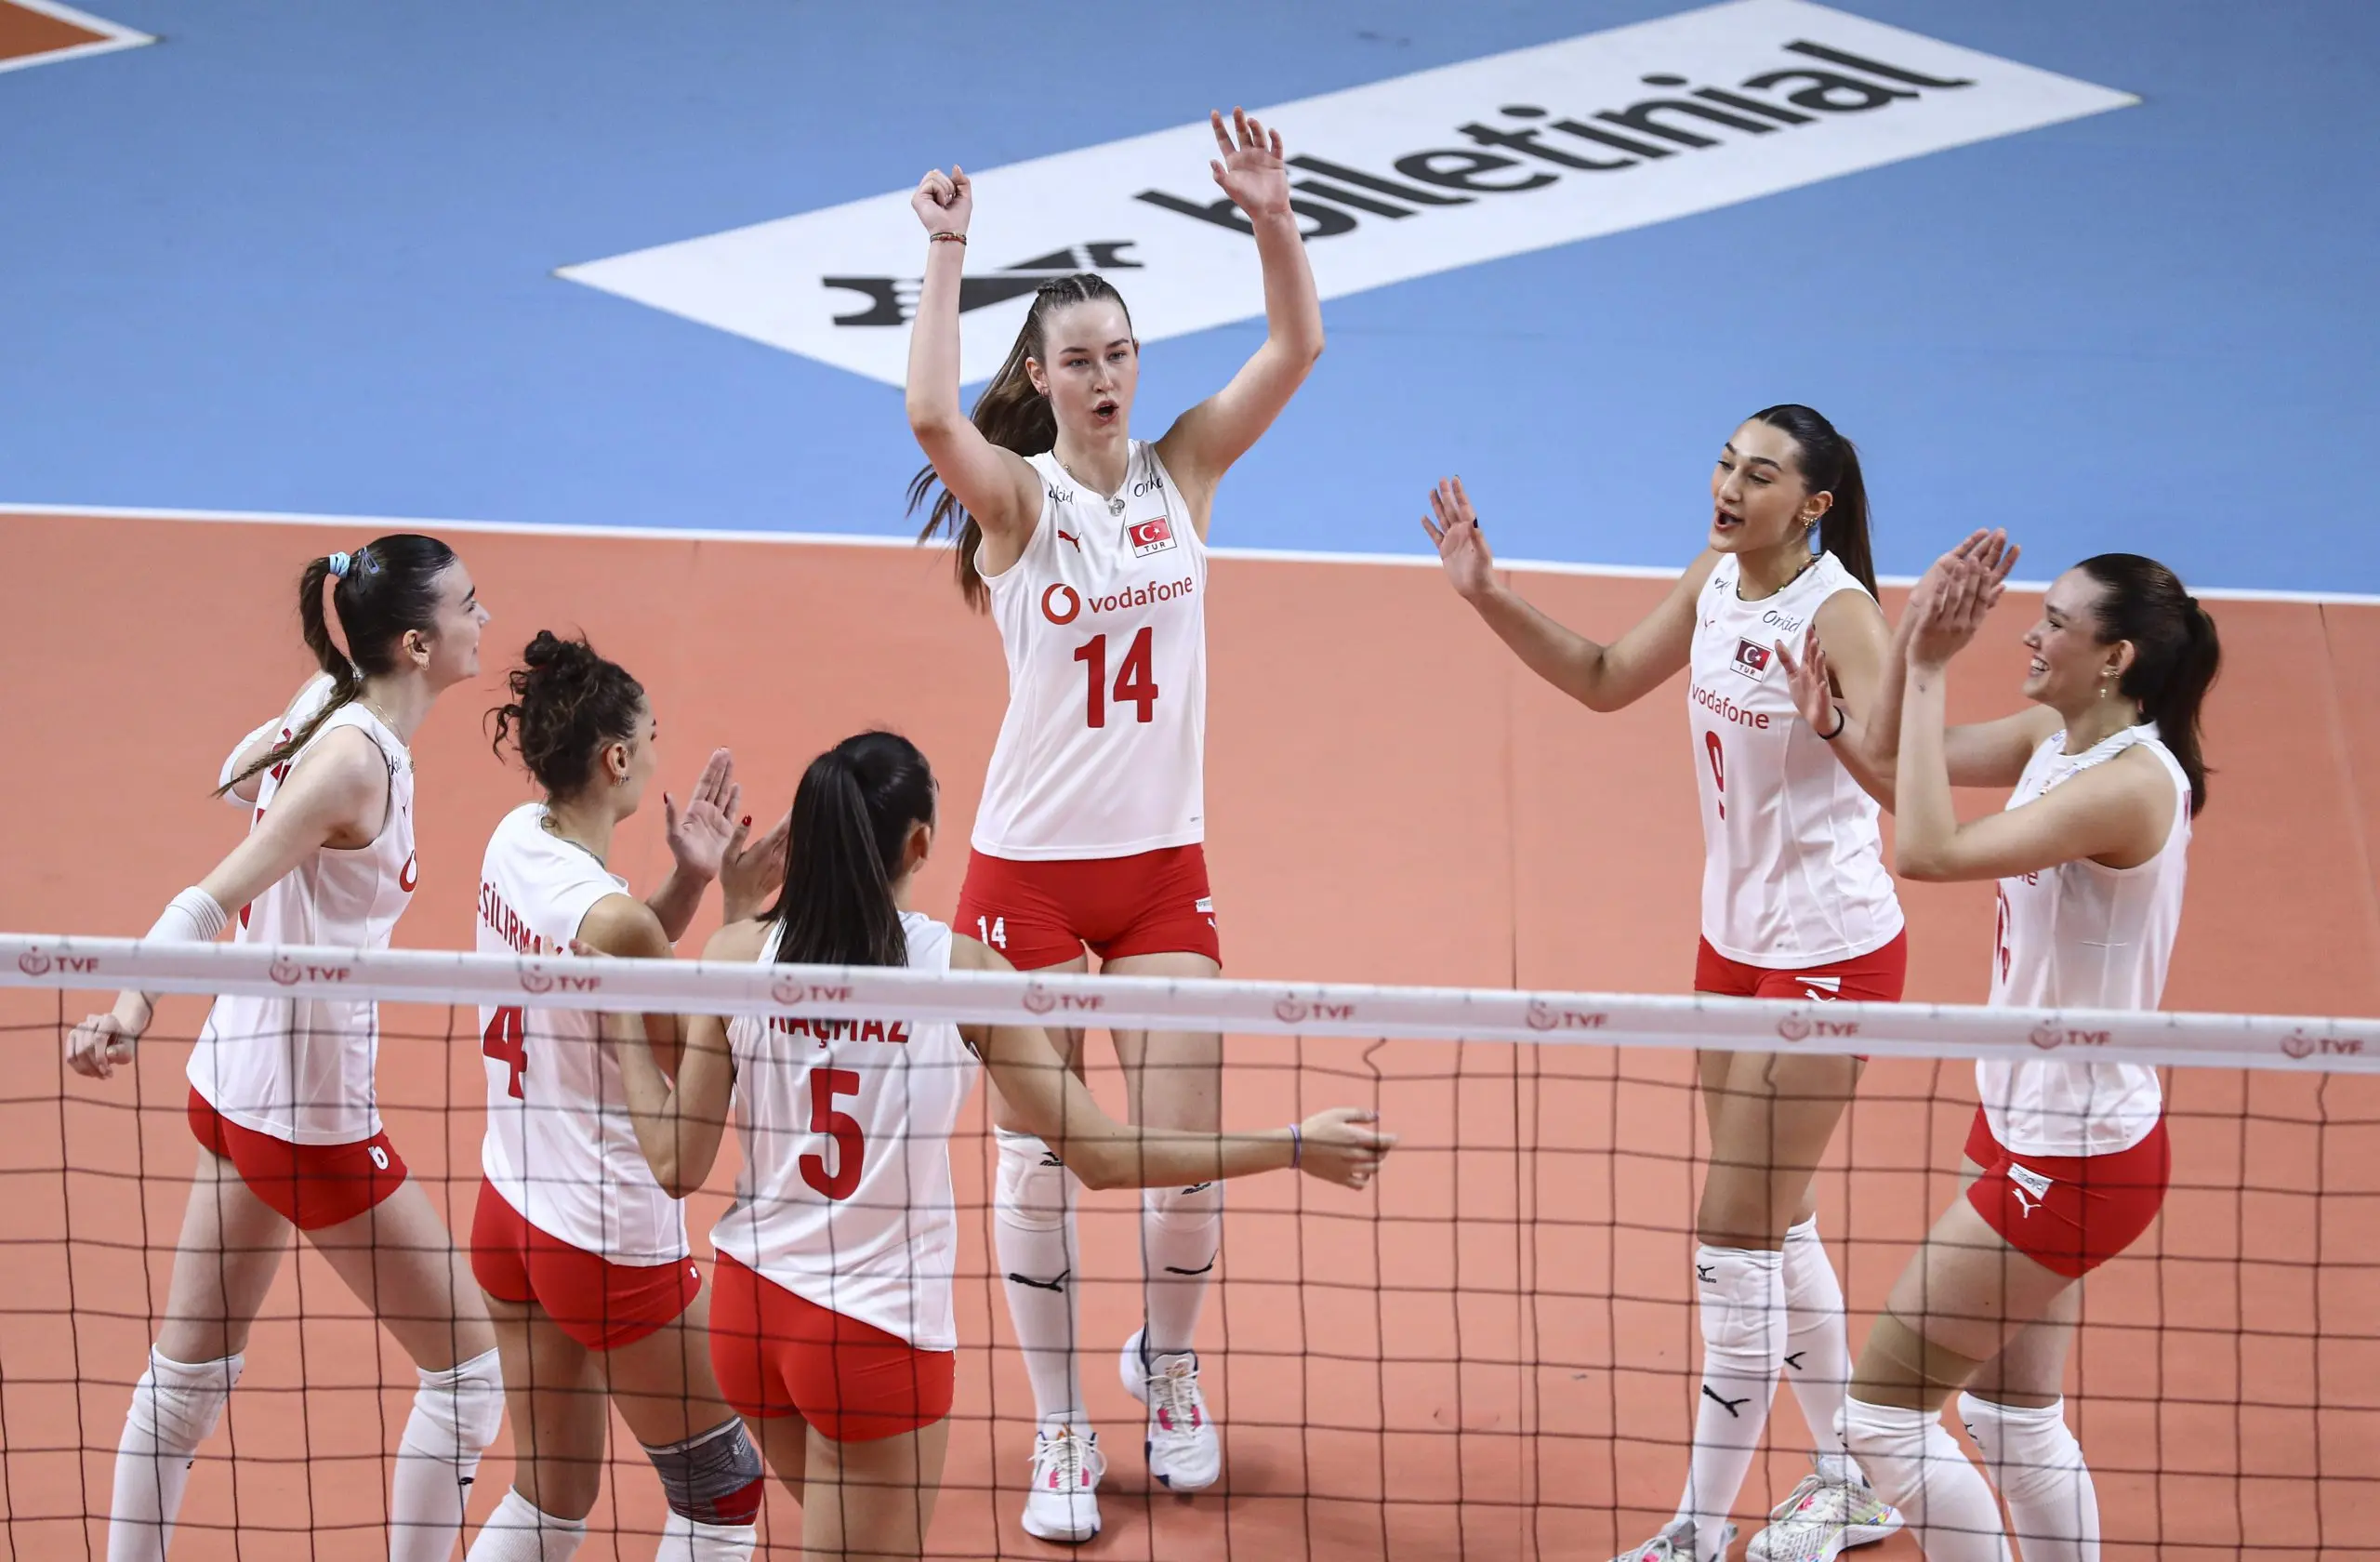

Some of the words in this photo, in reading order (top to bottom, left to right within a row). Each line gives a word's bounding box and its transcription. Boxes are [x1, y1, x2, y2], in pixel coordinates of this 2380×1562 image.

[1144, 541, 1166, 552] TUR
[1088, 576, 1193, 615] vodafone
[1762, 610, 1805, 634] Orkid
[1074, 626, 1159, 729] 14
[1739, 664, 1756, 676] TUR
[1691, 683, 1770, 730] vodafone
[977, 915, 1007, 949] 14
[55, 957, 99, 973] TVF
[307, 966, 351, 983] TVF
[558, 975, 602, 992] TVF
[810, 986, 854, 1002] TVF
[1061, 995, 1104, 1011] TVF
[1312, 1004, 1356, 1020] TVF
[1564, 1012, 1608, 1027] TVF
[1815, 1021, 1860, 1037] TVF
[2067, 1030, 2112, 1046] TVF
[483, 1005, 528, 1100] 4
[2320, 1039, 2365, 1055] TVF
[799, 1067, 865, 1200] 5
[367, 1145, 390, 1170] 6
